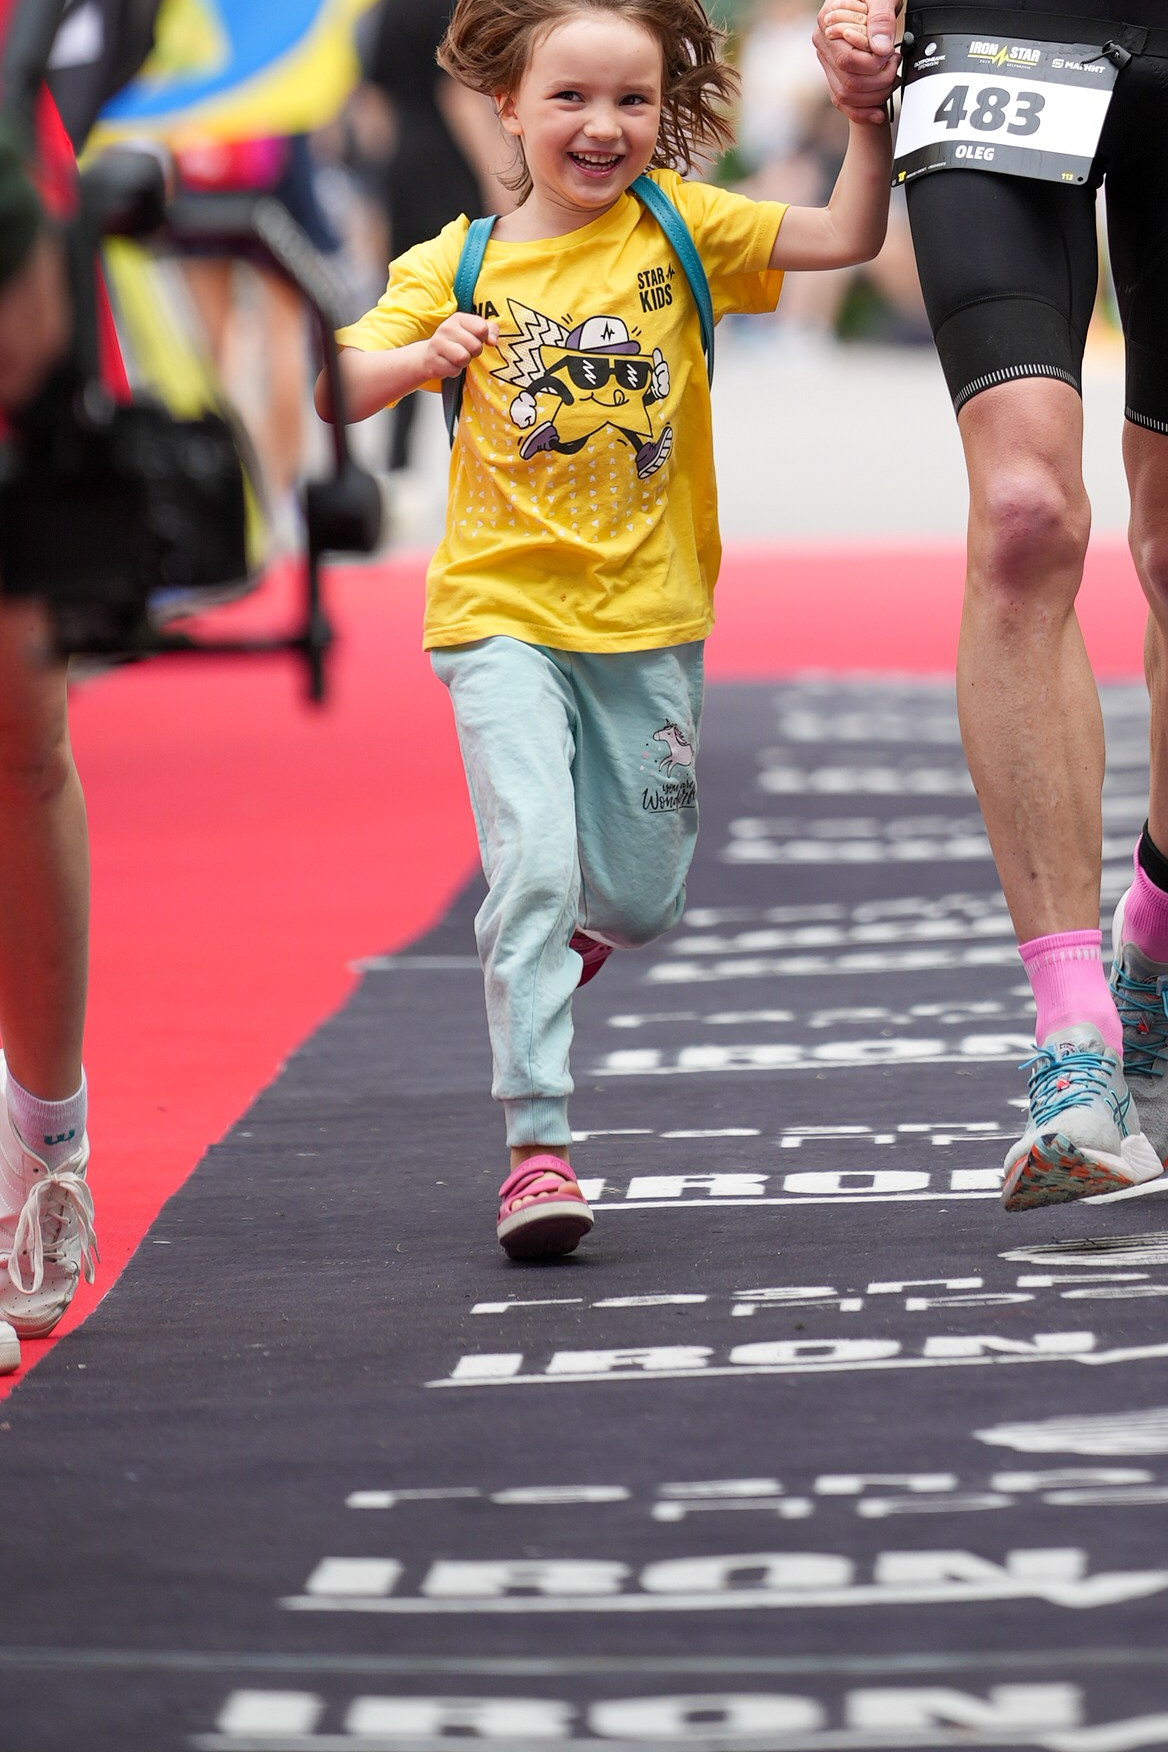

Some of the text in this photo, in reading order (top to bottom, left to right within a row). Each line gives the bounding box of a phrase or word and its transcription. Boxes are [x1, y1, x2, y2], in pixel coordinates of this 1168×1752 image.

[969, 40, 1041, 63] IRON STAR
[933, 85, 1046, 137] 483
[955, 144, 995, 162] OLEG
[637, 266, 666, 290] STAR
[639, 283, 673, 313] KIDS
[452, 1331, 1097, 1379] IRON
[304, 1548, 1087, 1596] IRON
[215, 1682, 1085, 1738] IRON
